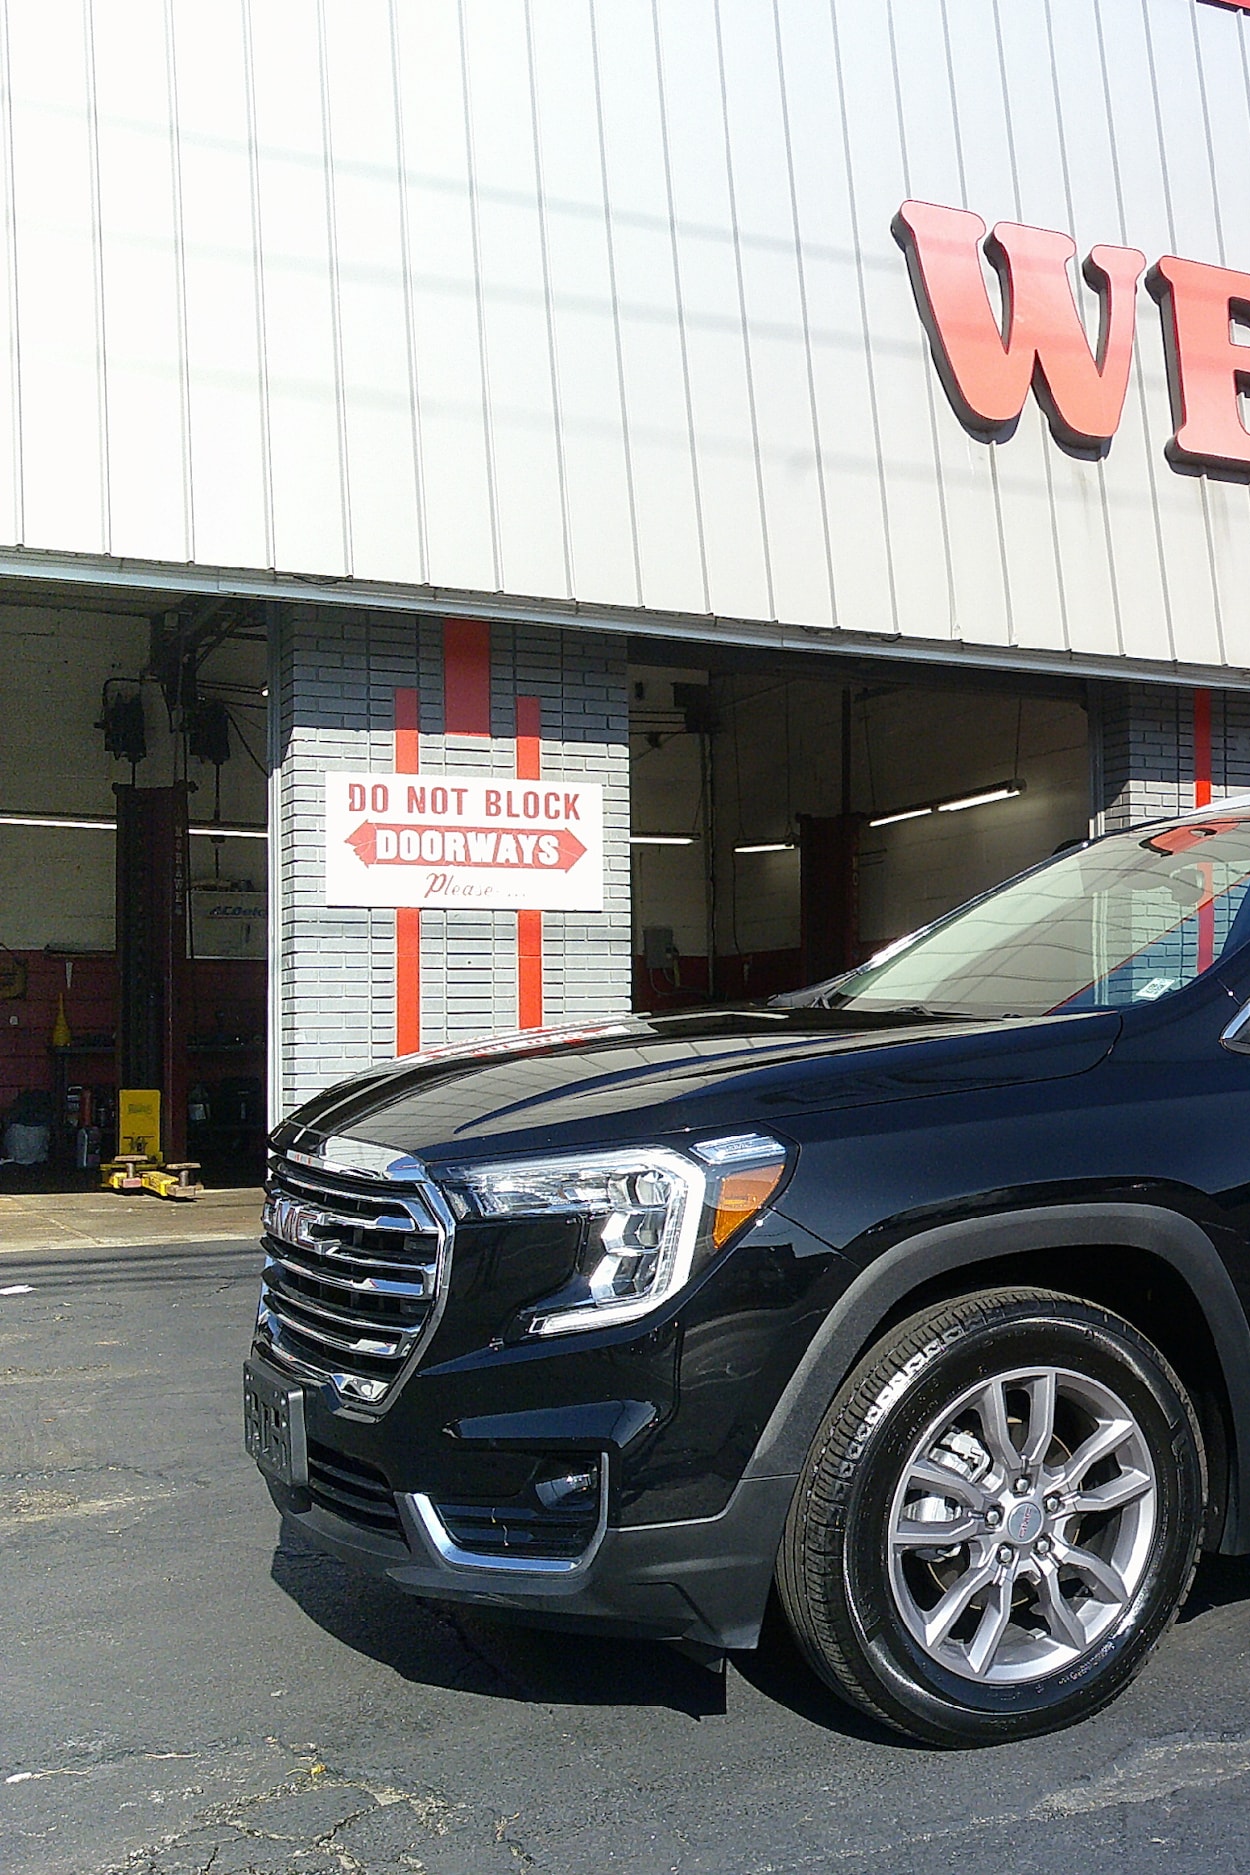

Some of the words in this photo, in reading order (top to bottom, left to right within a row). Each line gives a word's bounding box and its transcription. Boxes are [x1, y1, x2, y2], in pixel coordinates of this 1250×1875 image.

[348, 783, 389, 813] DO
[407, 786, 469, 815] NOT
[485, 789, 581, 821] BLOCK
[375, 828, 560, 866] DOORWAYS
